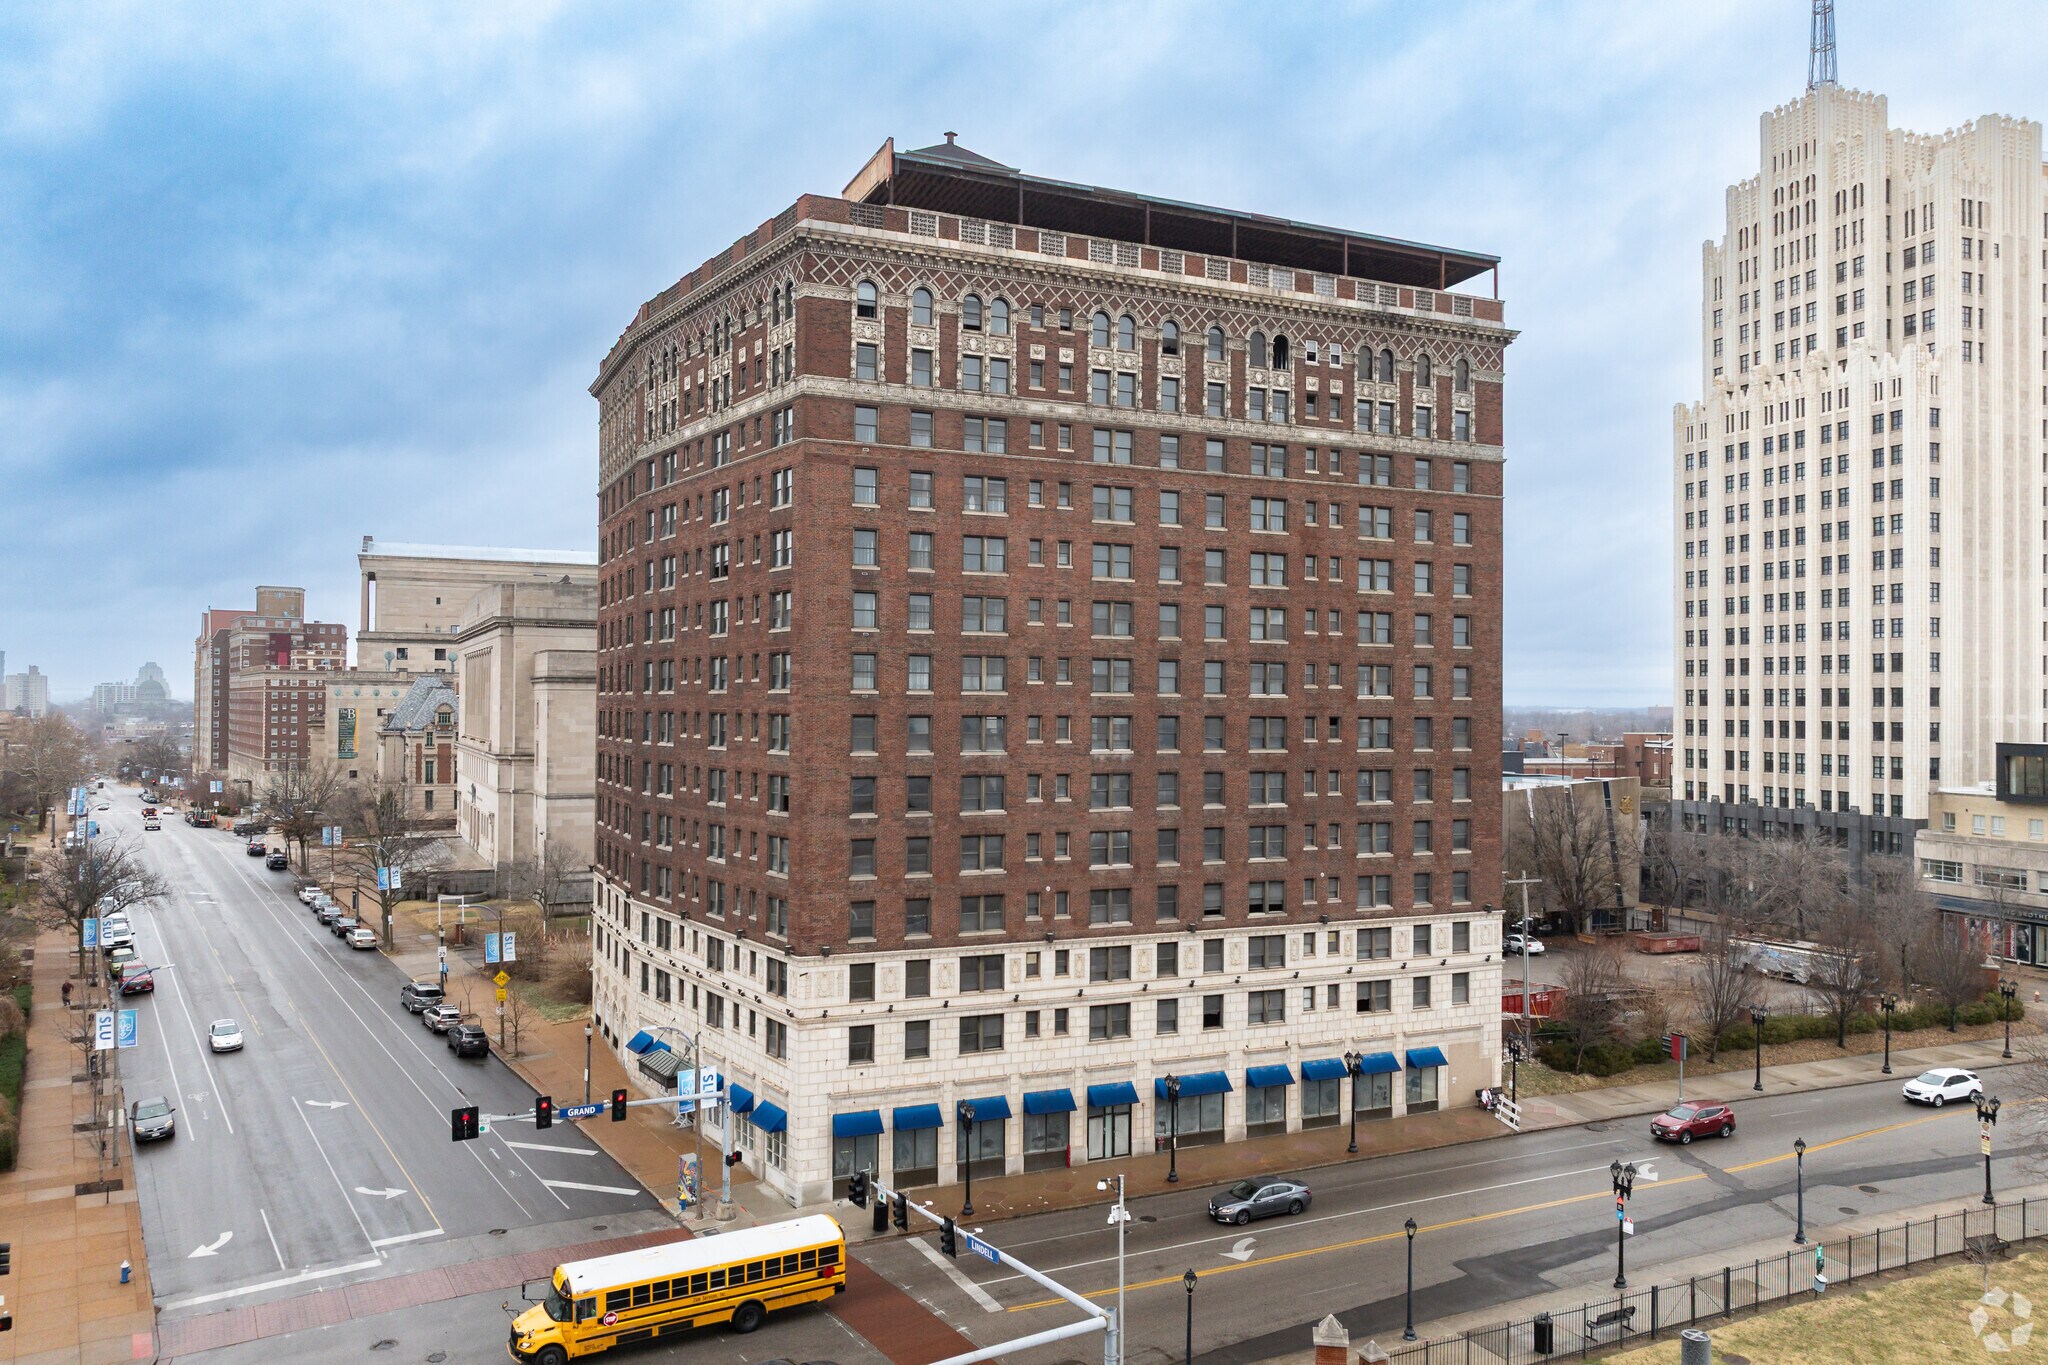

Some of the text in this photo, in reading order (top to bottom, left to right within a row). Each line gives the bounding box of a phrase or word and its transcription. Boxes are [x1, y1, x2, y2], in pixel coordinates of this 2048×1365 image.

[102, 921, 112, 939] SLU
[504, 935, 513, 955] SLU
[100, 1016, 111, 1040] SLU
[567, 1106, 596, 1117] GRAND
[971, 1240, 994, 1260] LINDELL
[605, 1315, 617, 1323] STOP
